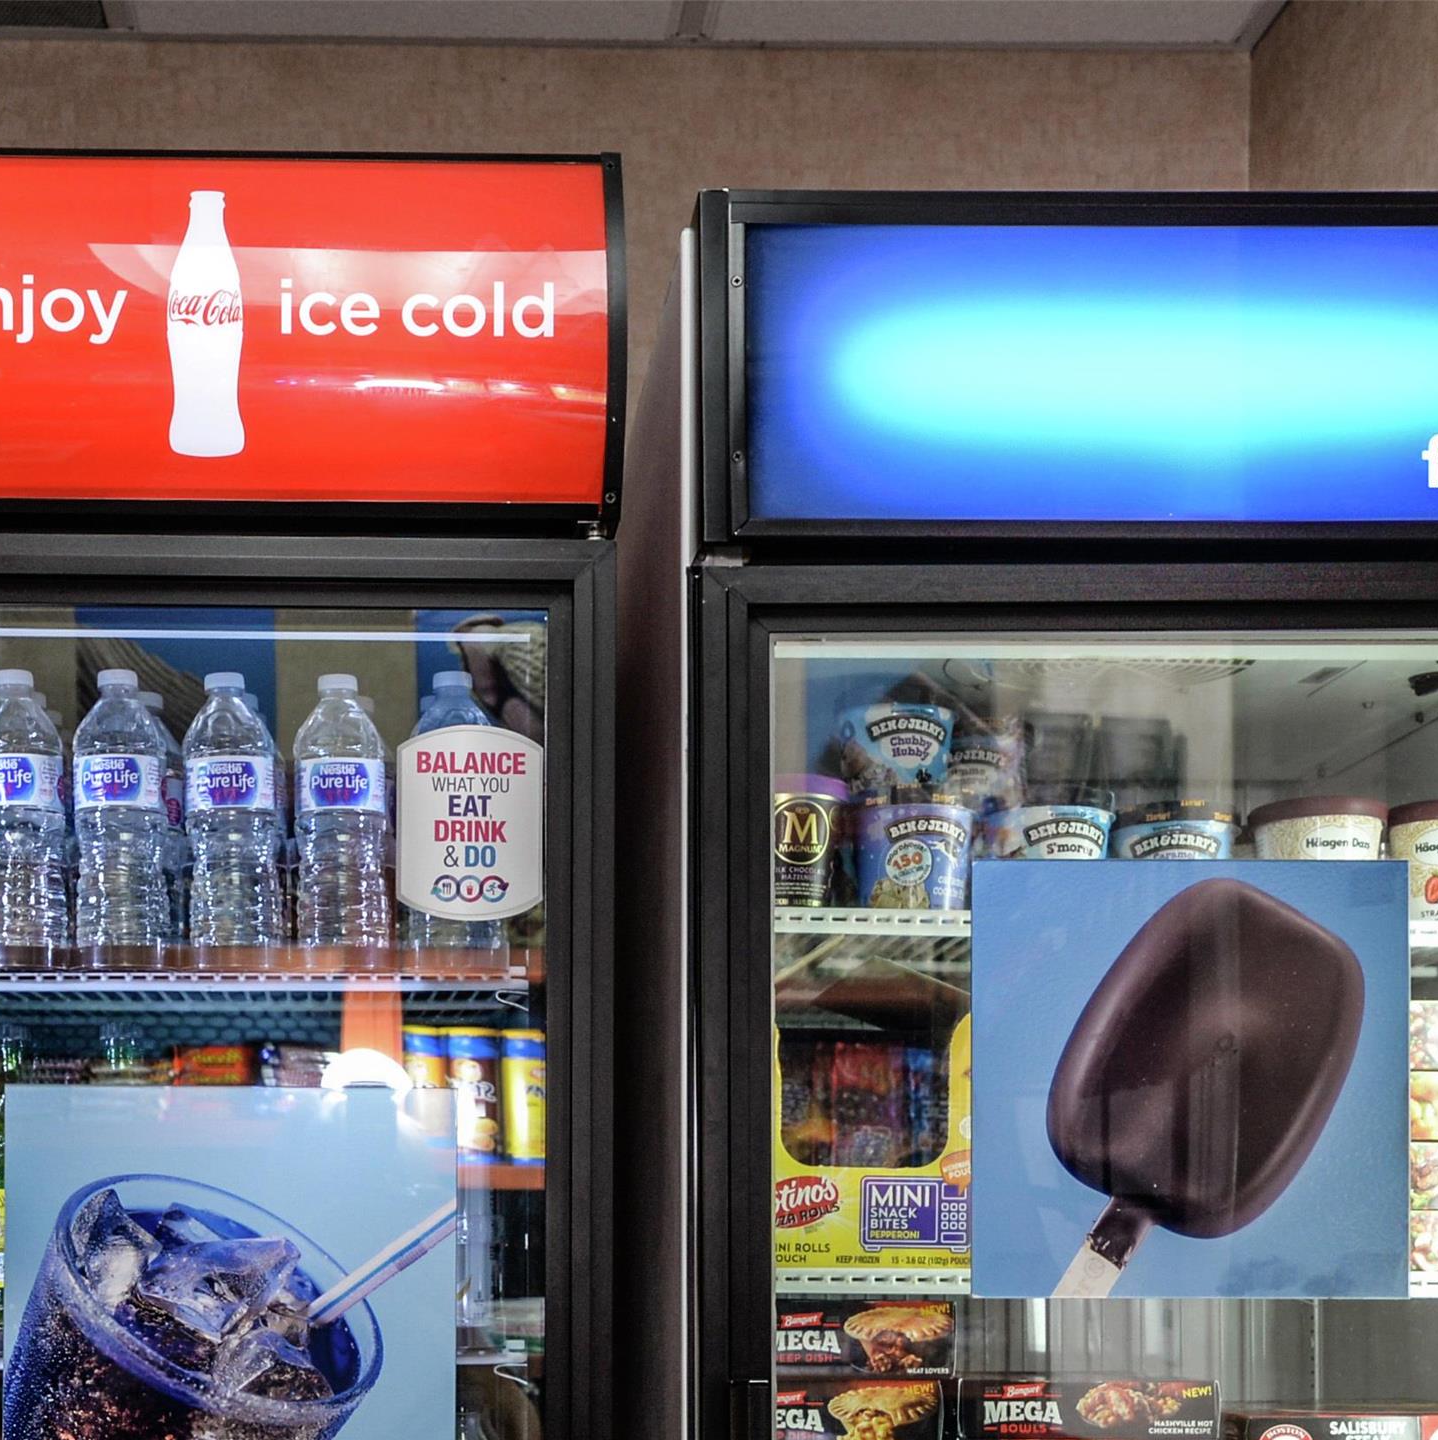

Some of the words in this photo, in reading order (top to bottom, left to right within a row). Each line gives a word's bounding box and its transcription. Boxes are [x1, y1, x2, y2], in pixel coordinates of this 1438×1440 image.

[168, 288, 243, 328] Coca-Cola
[279, 278, 381, 337] ice
[401, 281, 555, 338] cold
[890, 735, 932, 750] Chubby
[892, 748, 929, 761] Hubby
[416, 751, 526, 776] BALANCE
[8, 770, 32, 785] Life
[114, 770, 139, 786] Life
[232, 773, 256, 791] Life
[311, 776, 342, 790] Pure
[345, 775, 368, 791] Life
[432, 776, 472, 792] WHAT
[478, 776, 510, 793] YOU
[448, 796, 493, 819] EAT,
[433, 820, 507, 843] DRINK
[443, 846, 460, 867] &
[464, 846, 496, 868] DO
[892, 852, 923, 869] 150
[871, 1185, 930, 1207] MINI
[870, 1208, 917, 1218] SNACK
[870, 1219, 908, 1230] BITES
[870, 1230, 919, 1239] PEPPERONI
[795, 1243, 830, 1253] ROLLS
[836, 1256, 852, 1264] KEEP
[854, 1256, 880, 1264] FROZEN
[1182, 1386, 1212, 1399] NEW!
[983, 1401, 1063, 1424] MEGA
[1000, 1424, 1047, 1433] BOWLS
[1148, 1427, 1182, 1435] CHICKEN
[1266, 1427, 1306, 1439] BOSTON
[1330, 1421, 1406, 1435] SALISBURY
